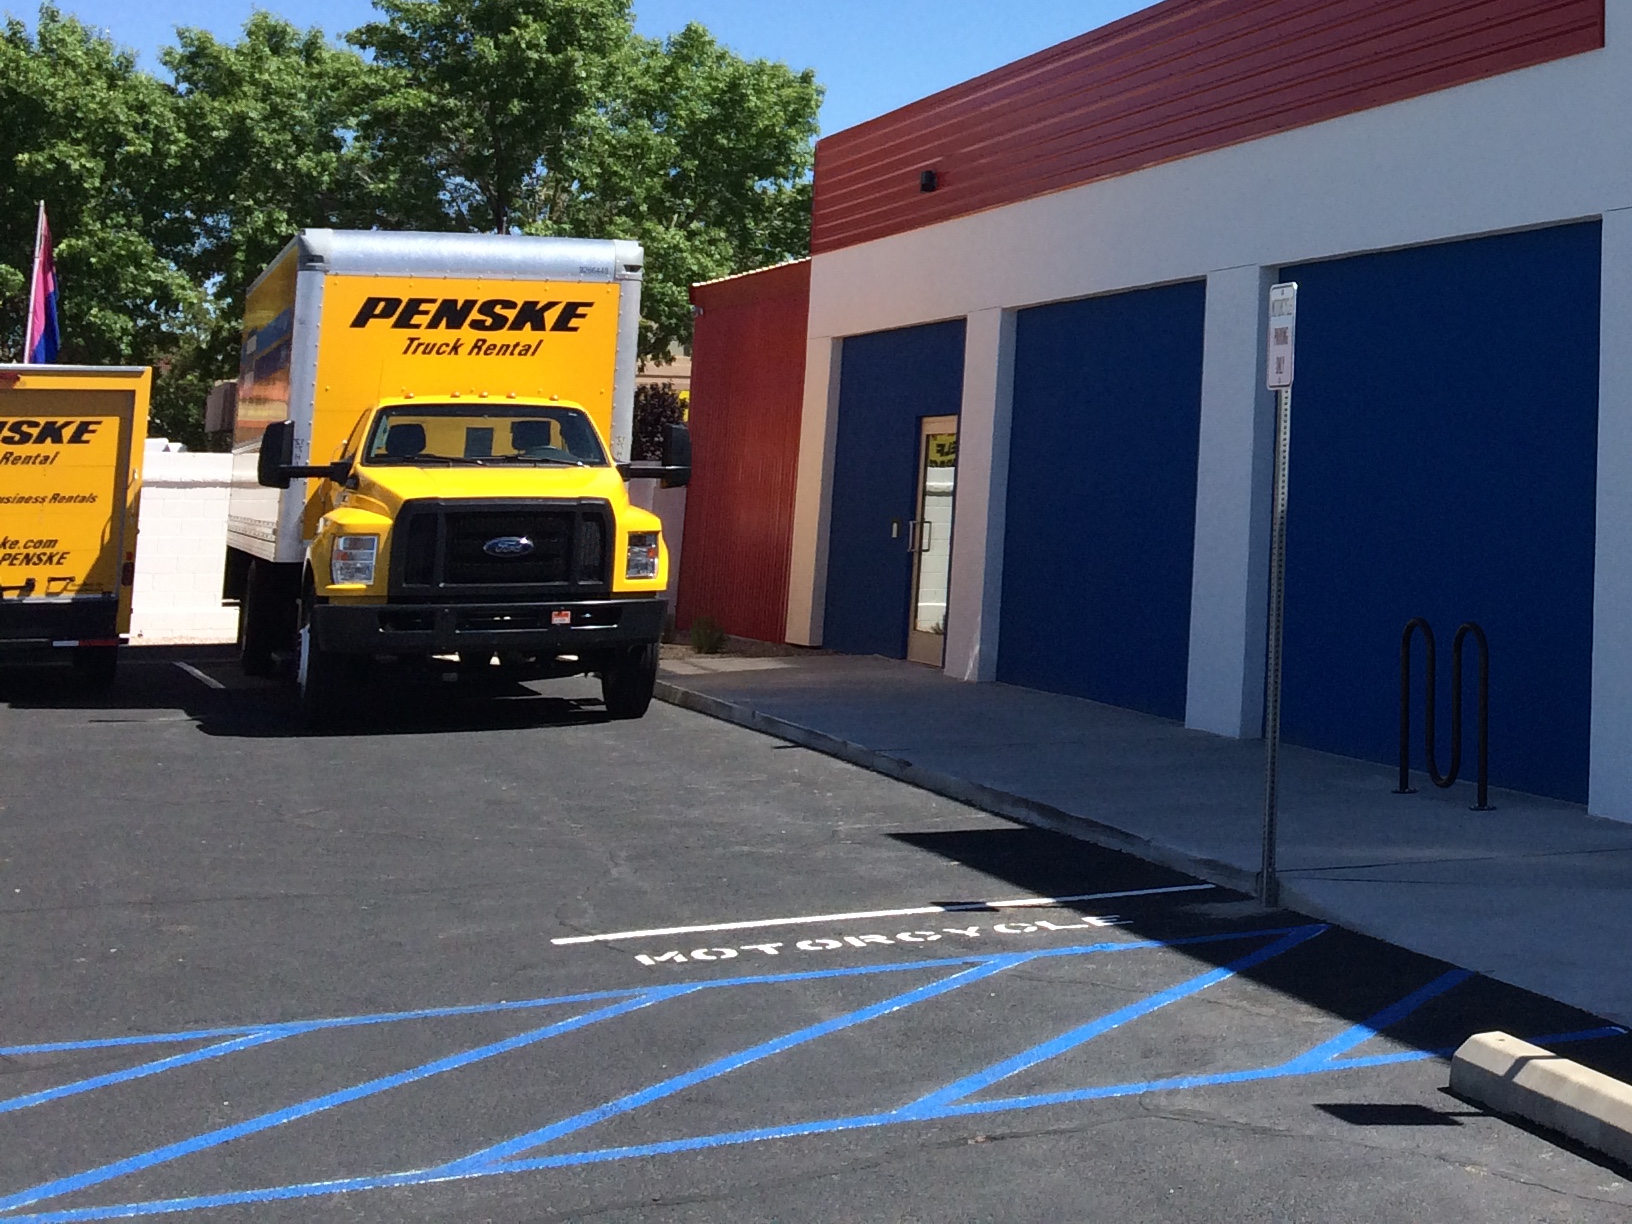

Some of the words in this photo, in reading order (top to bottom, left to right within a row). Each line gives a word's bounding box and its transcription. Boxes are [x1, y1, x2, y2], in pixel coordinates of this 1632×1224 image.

[349, 296, 595, 332] PENSKE
[402, 337, 465, 356] Truck
[467, 338, 544, 357] Rental
[0, 451, 60, 465] Rental
[49, 492, 98, 504] Rentals
[634, 914, 1134, 966] MOTORCYCLE
